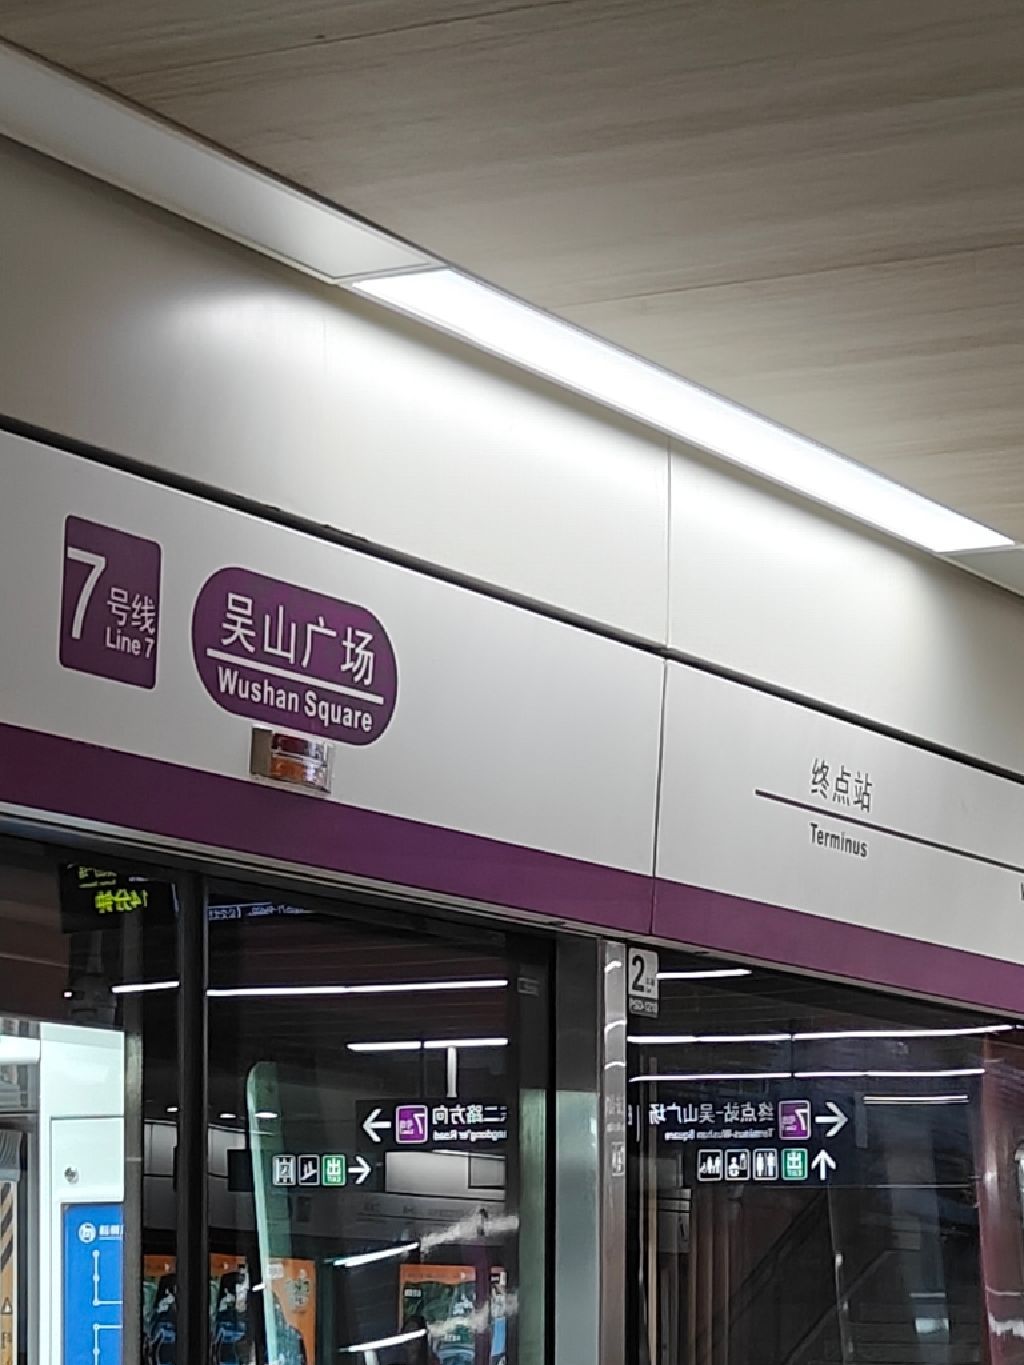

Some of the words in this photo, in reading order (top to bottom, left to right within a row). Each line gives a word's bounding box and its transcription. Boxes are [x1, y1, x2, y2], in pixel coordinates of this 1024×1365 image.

[67, 547, 106, 640] 7
[107, 588, 157, 635] 号线
[106, 626, 140, 656] Line
[144, 638, 155, 658] 7
[221, 592, 374, 687] 吴山广场
[217, 666, 299, 713] Wushan
[303, 691, 373, 733] Square
[810, 758, 872, 813] 终点站
[809, 823, 868, 857] Terminus
[632, 955, 645, 992] 2
